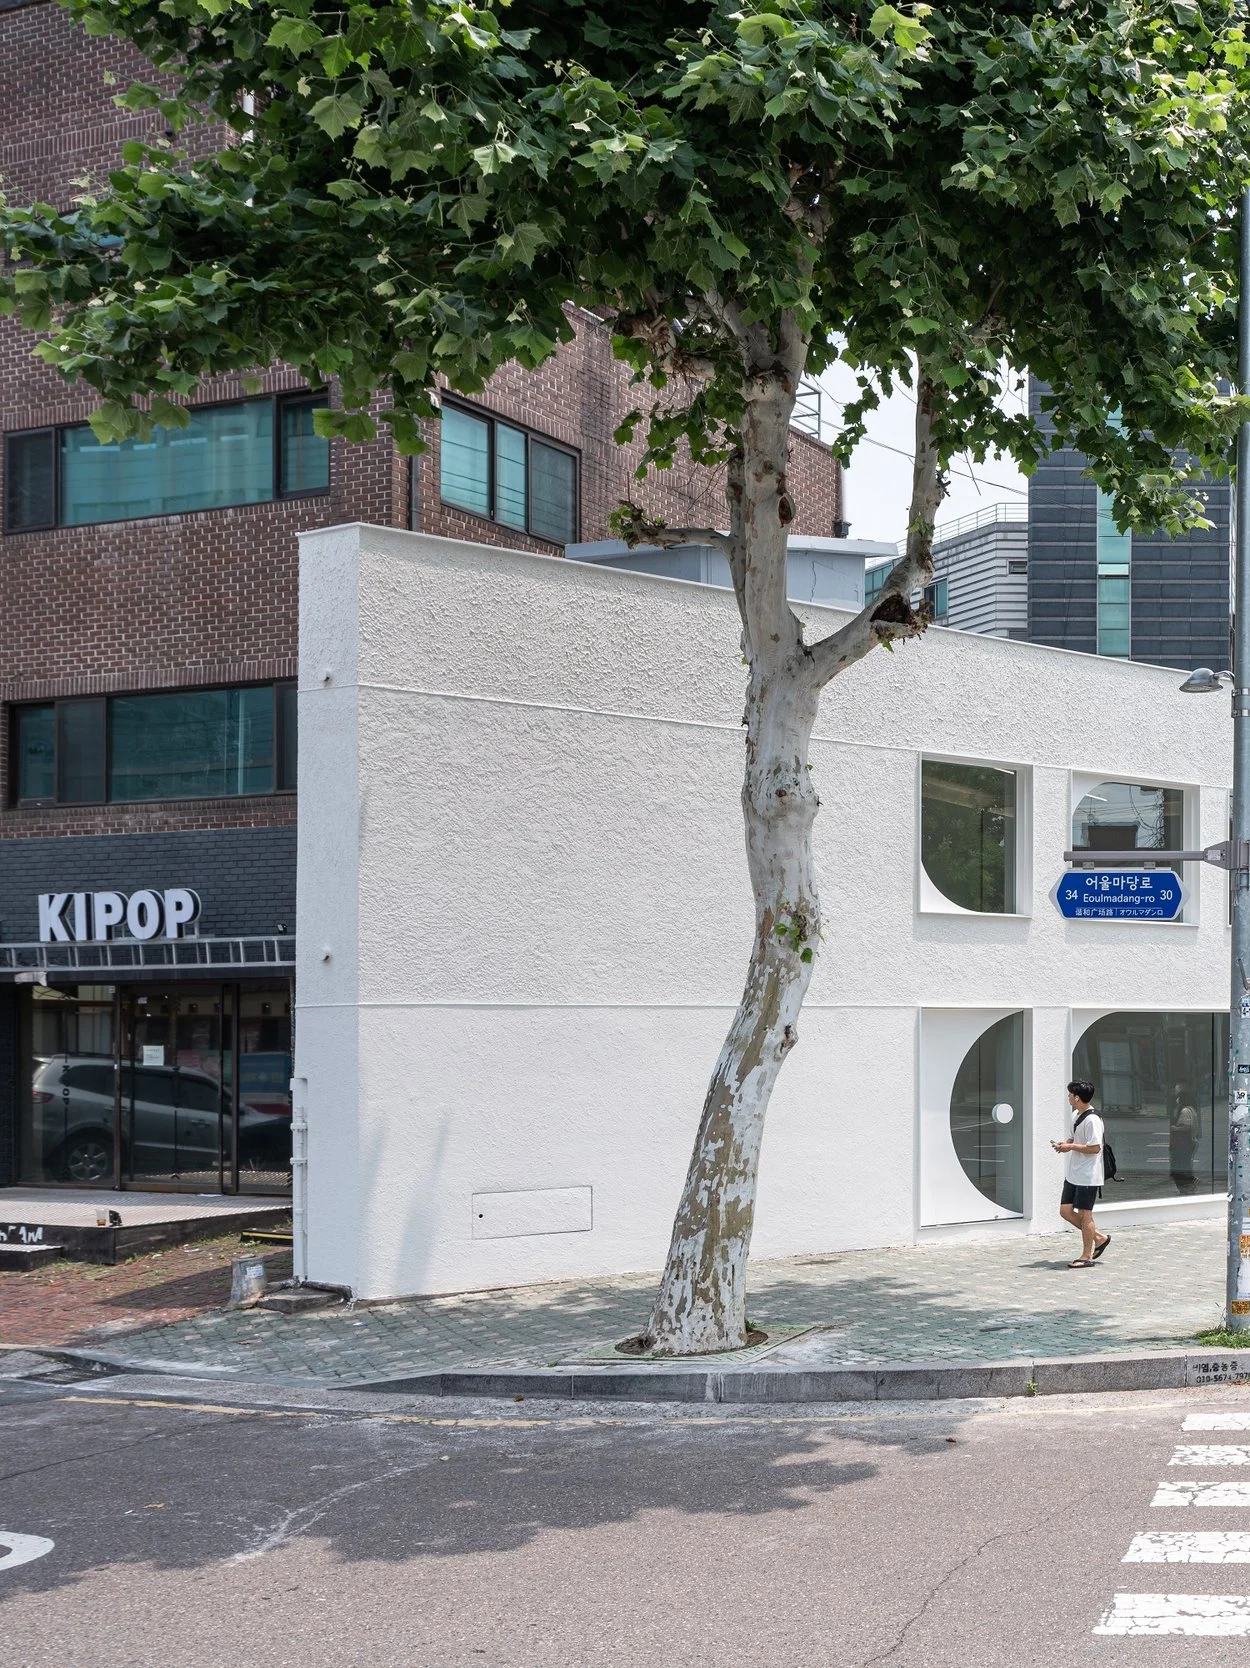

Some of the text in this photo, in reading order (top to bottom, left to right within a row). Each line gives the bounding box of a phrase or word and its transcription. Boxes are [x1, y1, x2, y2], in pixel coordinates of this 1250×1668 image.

[1085, 875, 1153, 891] 어울마당로
[1065, 889, 1173, 904] 34 Eoulmadang-ro 30
[38, 888, 201, 942] KIPOP
